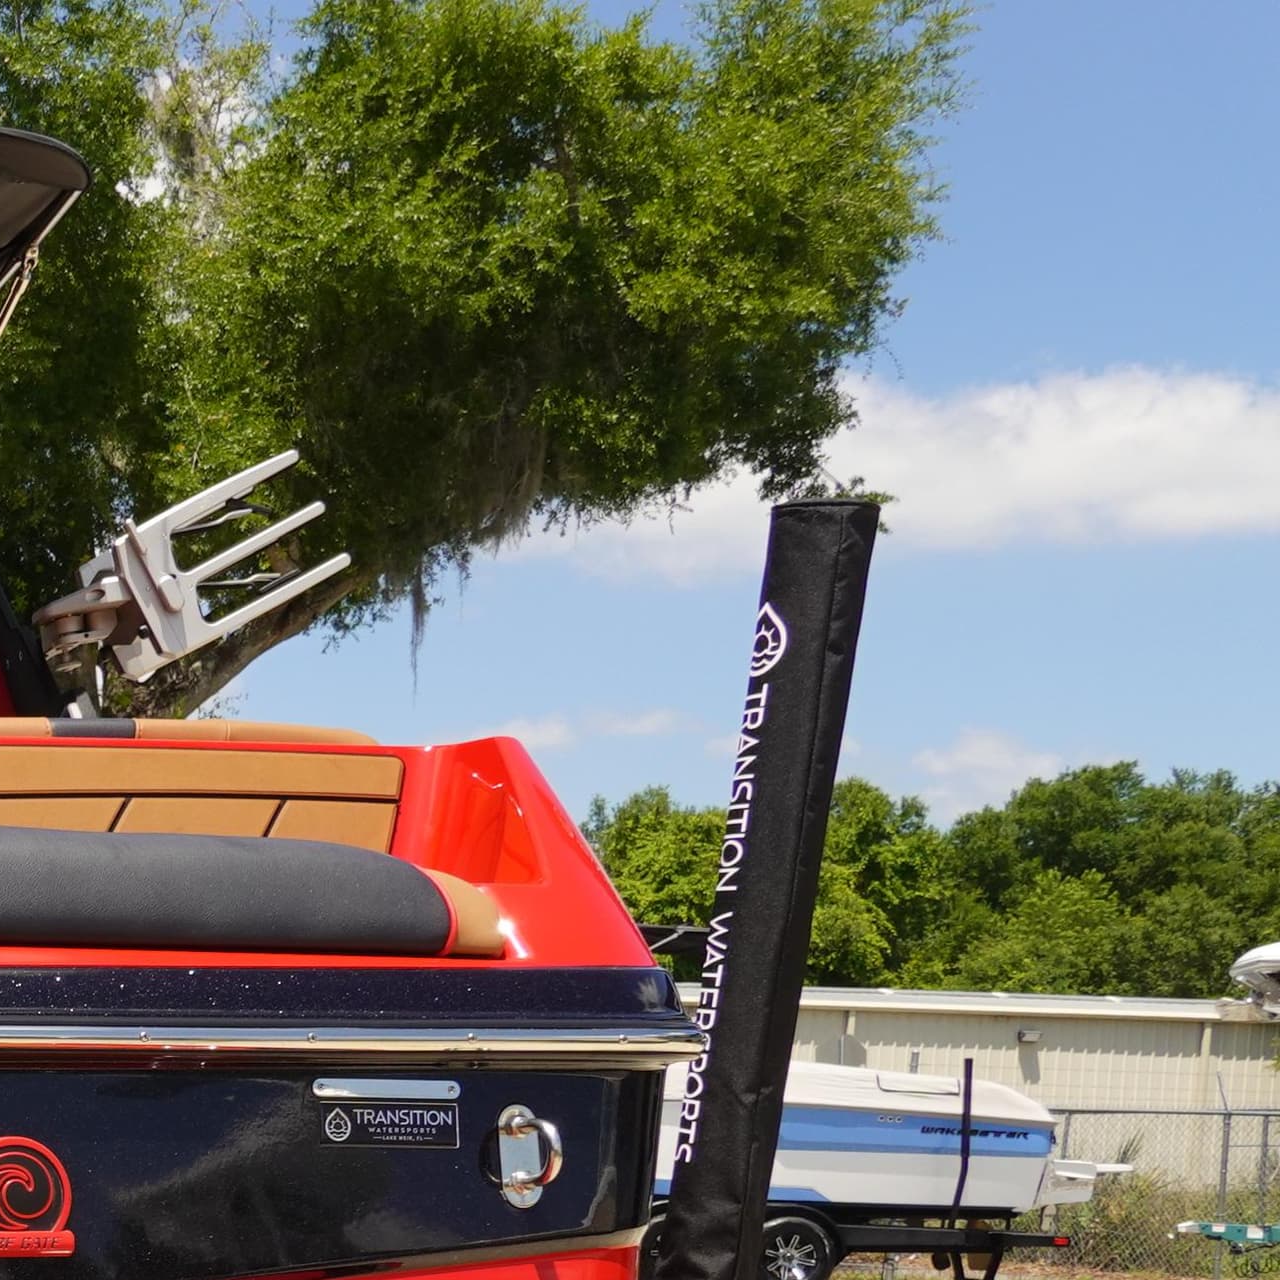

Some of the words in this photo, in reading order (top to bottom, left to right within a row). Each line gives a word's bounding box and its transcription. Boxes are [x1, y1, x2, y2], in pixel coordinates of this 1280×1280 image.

[715, 683, 769, 892] TRANSITION
[352, 1109, 453, 1126] TRANSITION
[368, 1127, 437, 1135] WATERSPORTS
